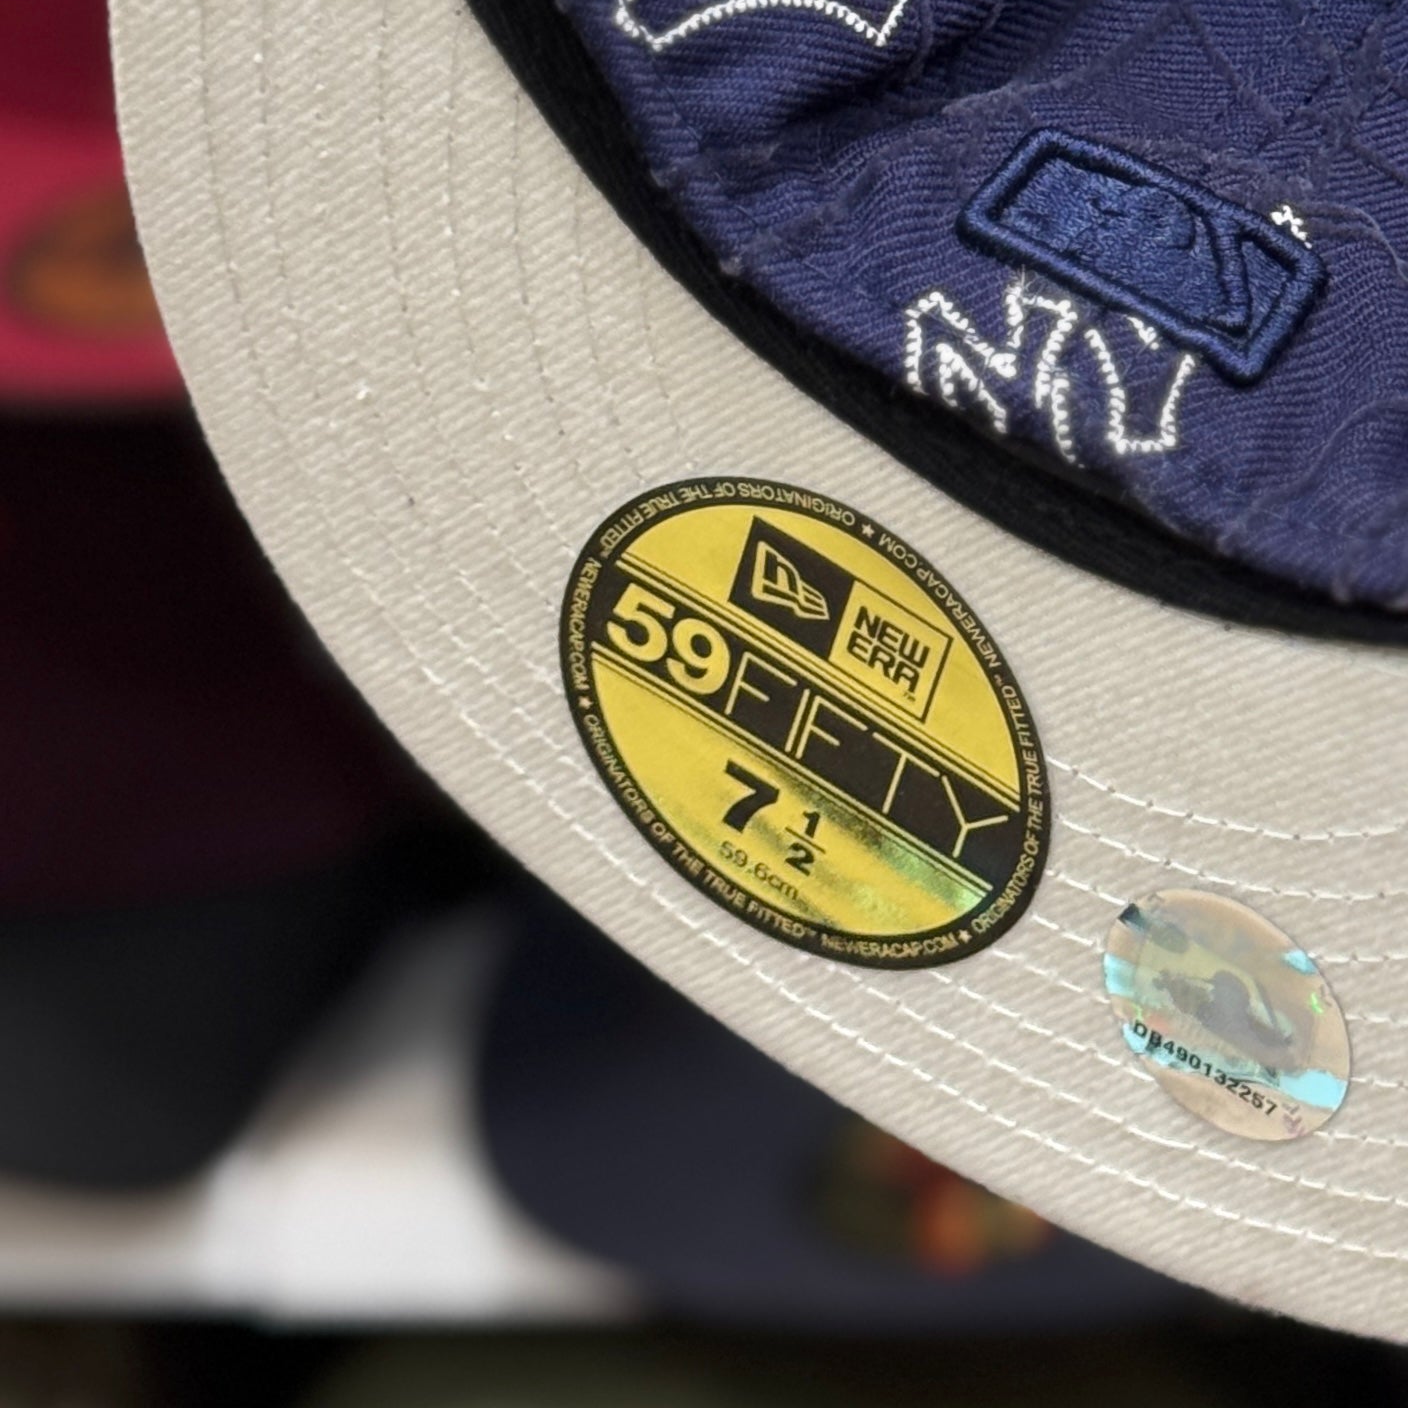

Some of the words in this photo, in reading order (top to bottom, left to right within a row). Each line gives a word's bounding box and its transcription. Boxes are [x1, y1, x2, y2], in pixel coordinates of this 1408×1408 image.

[639, 496, 681, 516] TRUE
[677, 483, 713, 505] THE
[712, 481, 735, 498] OF
[737, 481, 856, 527] ORIGINATORS
[878, 532, 1003, 669] NEWERACAP.COM
[846, 630, 921, 693] ERA
[854, 605, 931, 670] NEW
[606, 582, 1009, 859] 59FIFTY
[722, 758, 780, 834] 7
[1021, 748, 1043, 793] TRUE
[583, 714, 653, 827] ORIGINATORS
[652, 821, 676, 844] OF
[671, 841, 707, 877] THE
[703, 864, 746, 908] TRUE
[1027, 794, 1043, 831] THE
[718, 840, 801, 902] 59.6cm
[1023, 831, 1039, 855] OF
[971, 854, 1036, 934] ORIGINATORS
